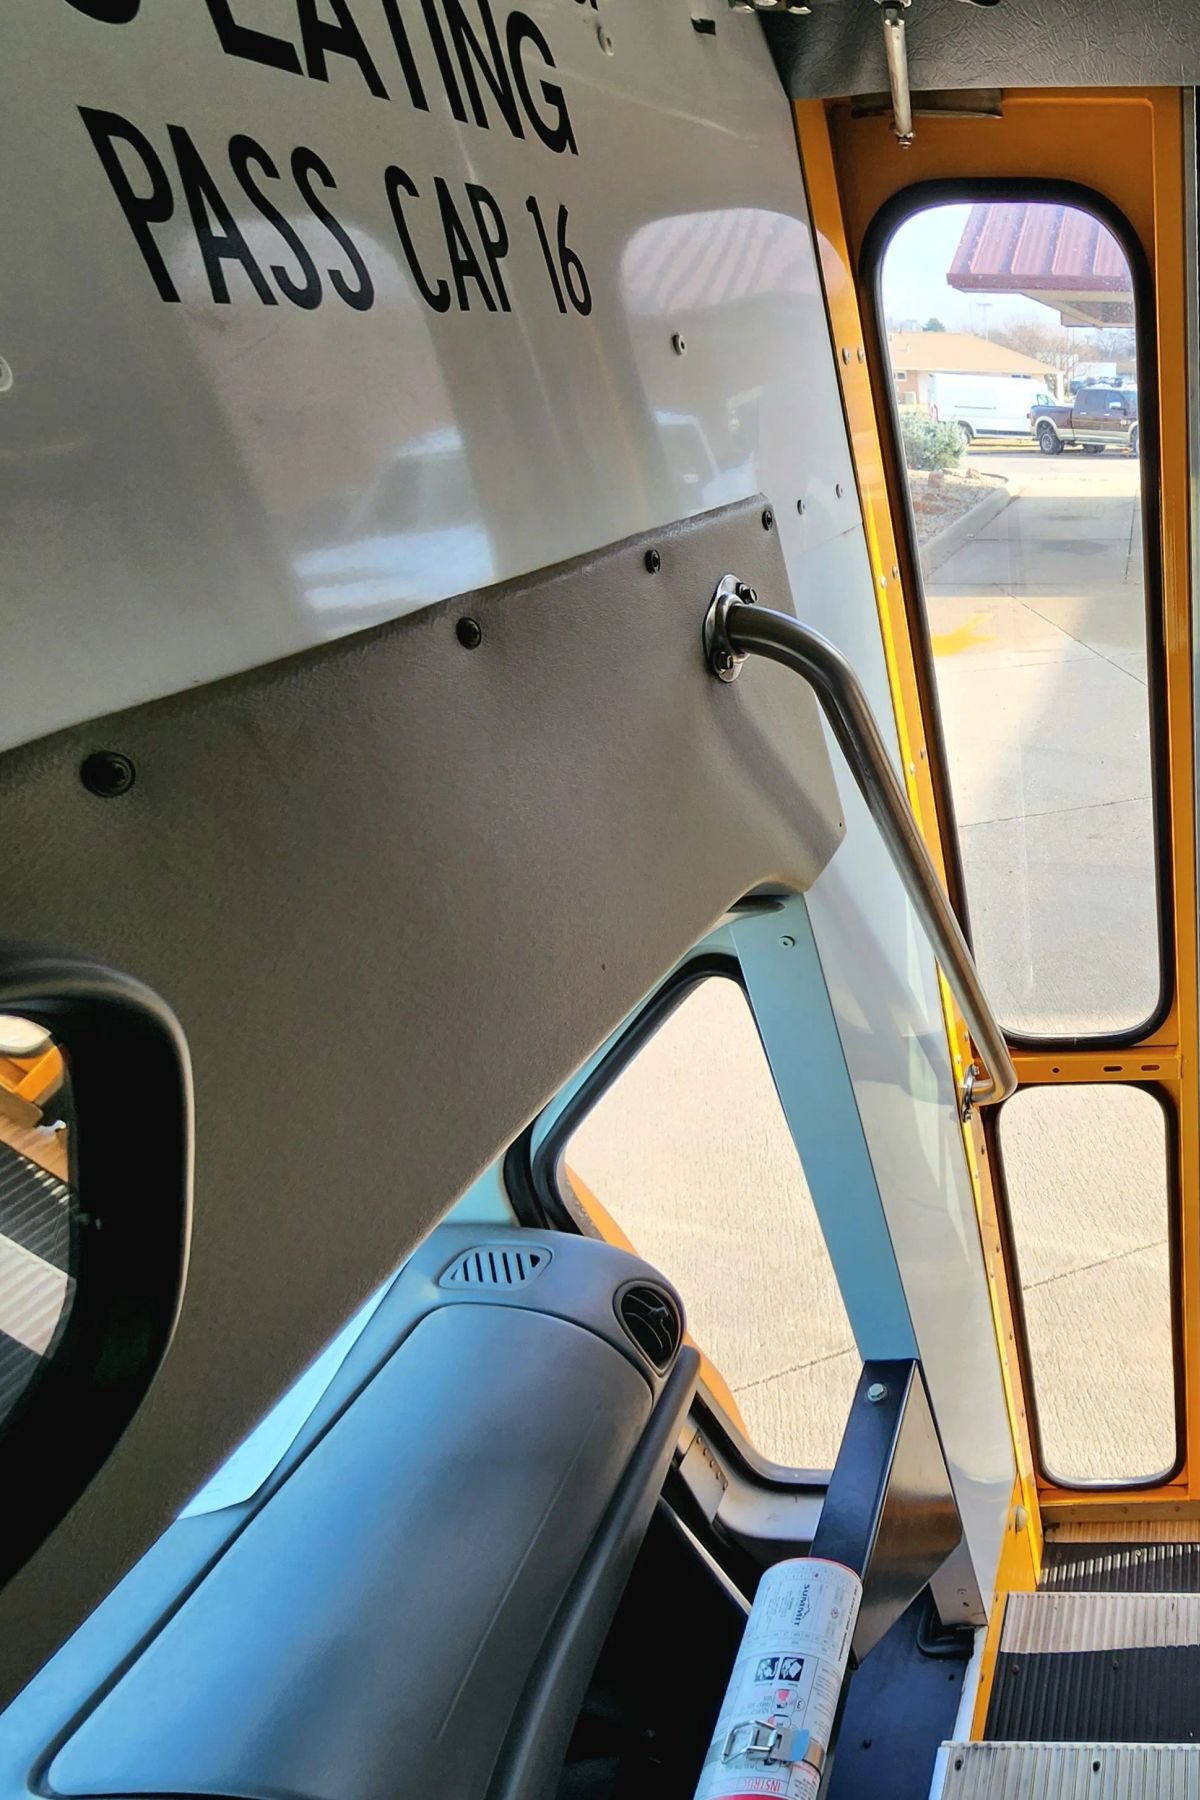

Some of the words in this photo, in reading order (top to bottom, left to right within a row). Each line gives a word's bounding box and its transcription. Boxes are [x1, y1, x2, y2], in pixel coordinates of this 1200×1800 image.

[77, 105, 376, 312] PASS
[384, 164, 512, 313] CAP
[525, 194, 592, 317] 16
[793, 1583, 811, 1627] SUMMIT
